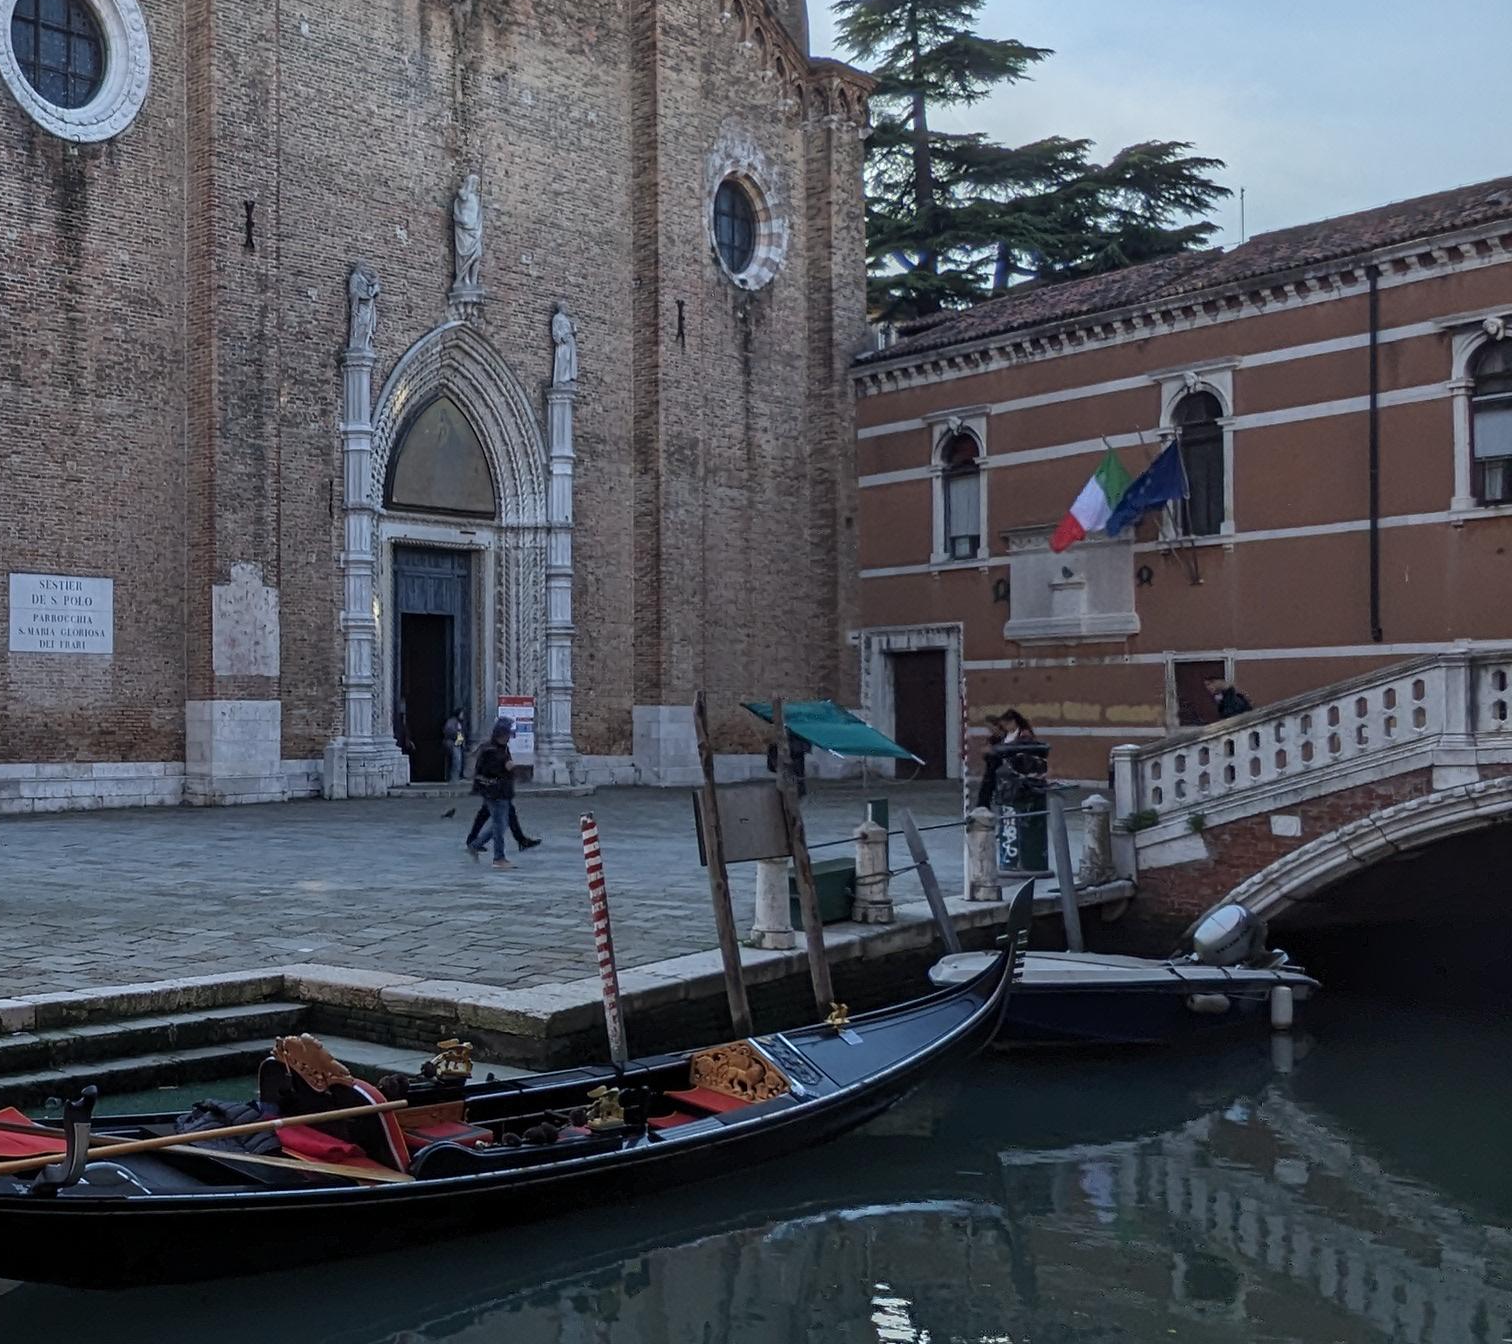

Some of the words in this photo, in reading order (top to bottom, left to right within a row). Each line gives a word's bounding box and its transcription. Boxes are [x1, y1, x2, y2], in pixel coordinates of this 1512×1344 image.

[39, 579, 82, 591] SESTIER
[32, 594, 46, 605] DE
[63, 595, 93, 607] POLO
[33, 613, 93, 624] PARROCCHIA
[60, 627, 105, 637] GLORIOSA
[39, 639, 55, 649] DEI
[59, 640, 86, 650] FRARI
